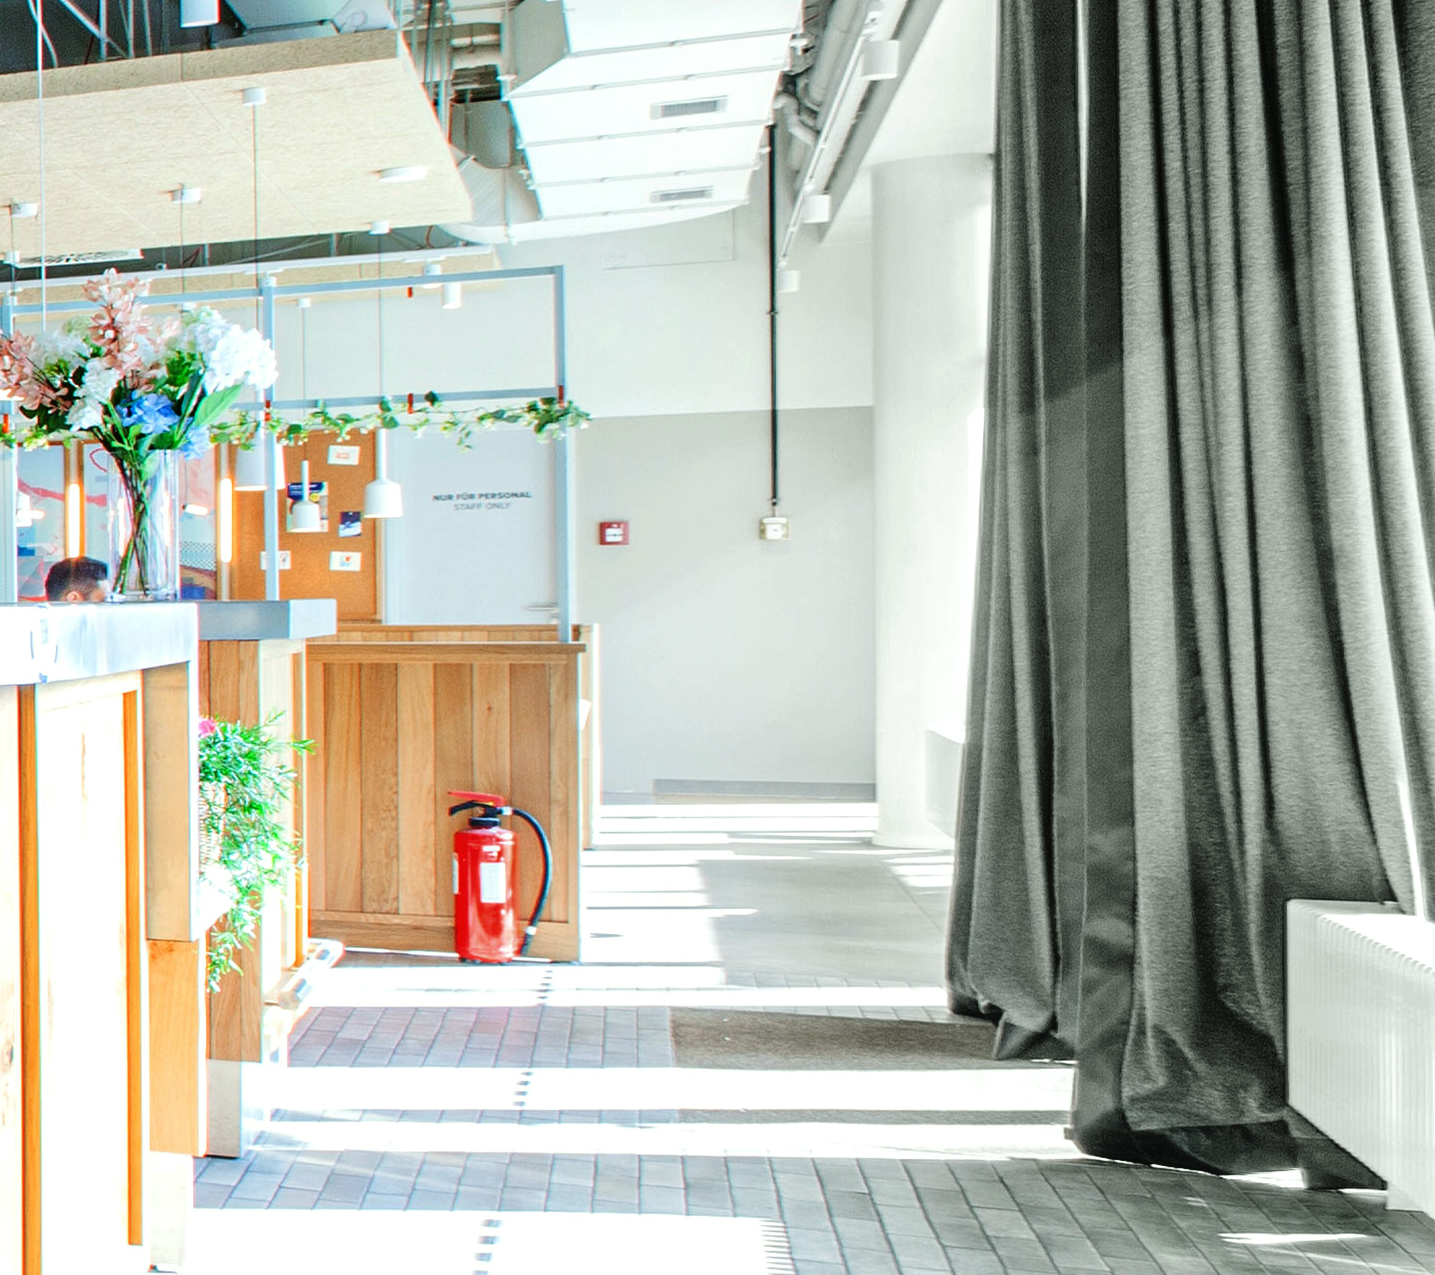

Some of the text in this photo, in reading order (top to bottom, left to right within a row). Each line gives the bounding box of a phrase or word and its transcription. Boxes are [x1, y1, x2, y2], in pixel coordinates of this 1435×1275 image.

[456, 492, 475, 500] FÜR
[478, 491, 532, 500] PERSONAL
[454, 502, 510, 511] STAFF ONLY
